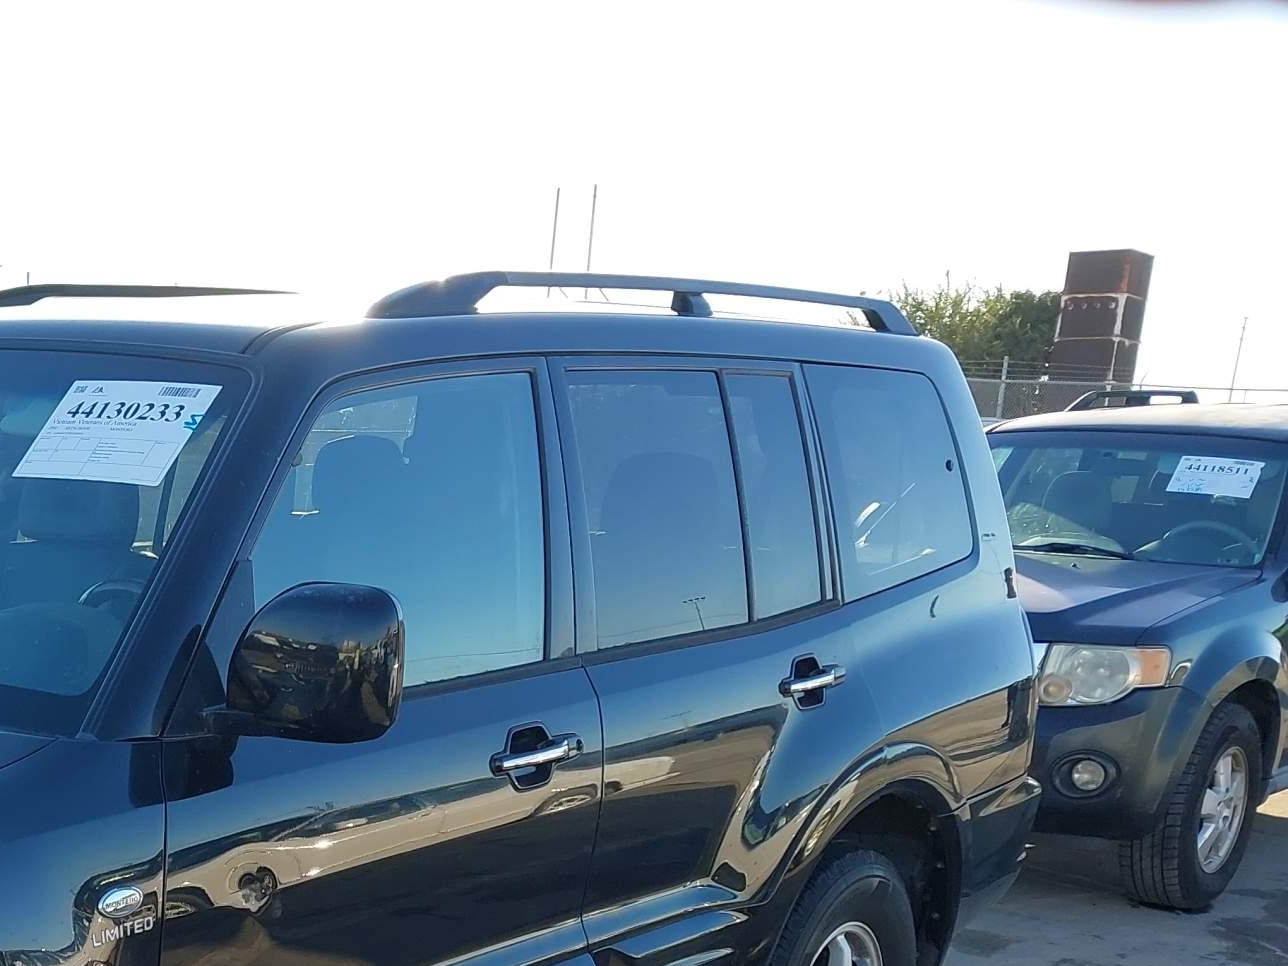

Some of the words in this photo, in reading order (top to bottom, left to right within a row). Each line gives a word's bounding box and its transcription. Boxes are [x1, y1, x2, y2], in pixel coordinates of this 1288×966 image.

[67, 400, 186, 423] 44130233
[1184, 463, 1249, 475] 44118511
[92, 916, 154, 948] LIMITED
